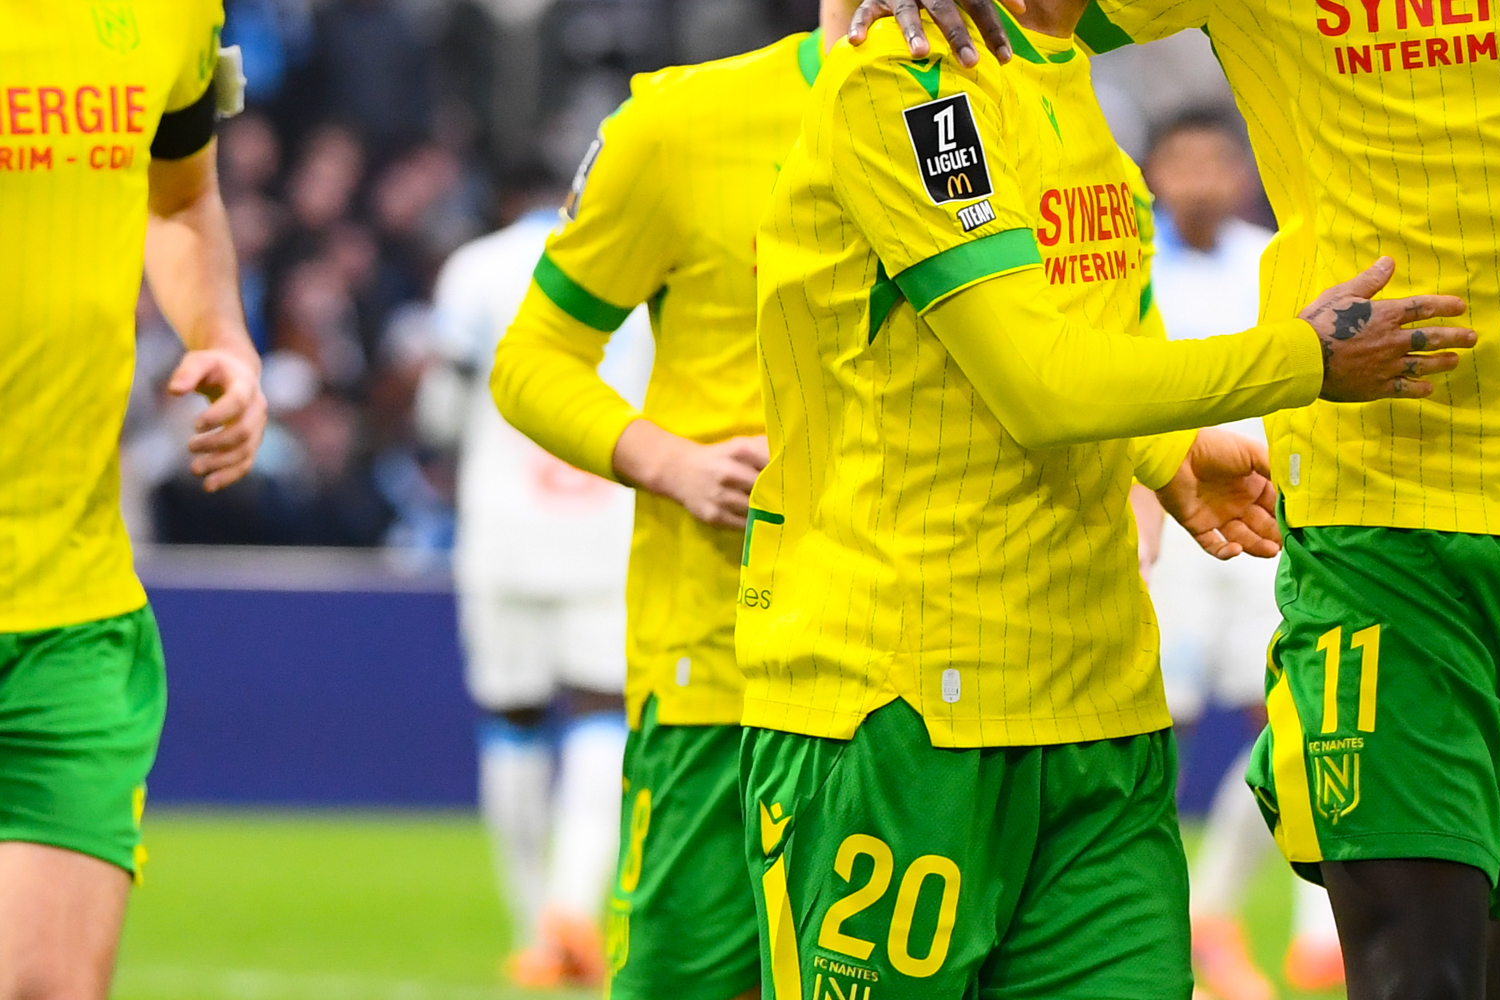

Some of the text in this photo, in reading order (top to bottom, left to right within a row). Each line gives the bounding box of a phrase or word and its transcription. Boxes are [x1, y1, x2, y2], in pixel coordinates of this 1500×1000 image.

[1334, 31, 1498, 75] INTERIM
[0, 85, 146, 135] ERGIE
[1045, 249, 1127, 285] INTERIM
[1315, 623, 1381, 734] 11
[1308, 737, 1364, 753] FC NANTES
[817, 833, 962, 978] 20
[814, 955, 879, 982] FC NANTES
